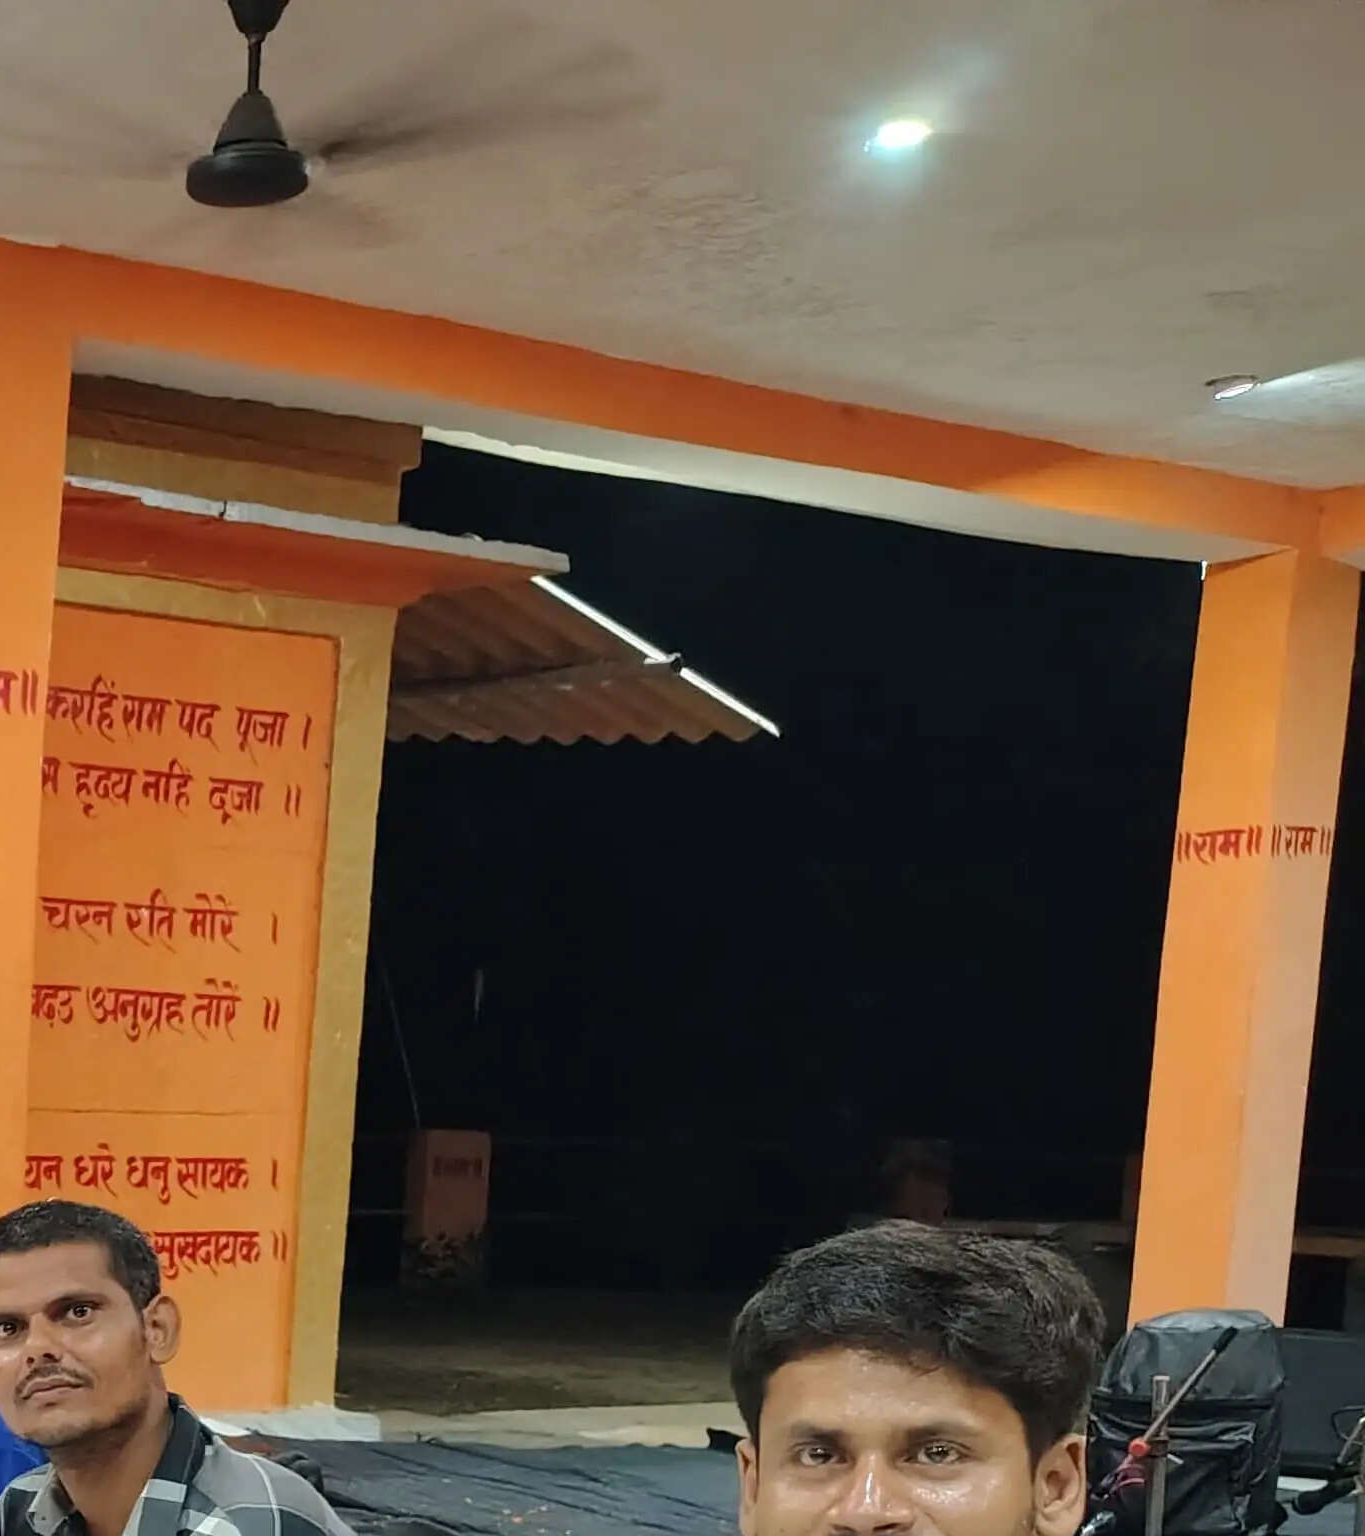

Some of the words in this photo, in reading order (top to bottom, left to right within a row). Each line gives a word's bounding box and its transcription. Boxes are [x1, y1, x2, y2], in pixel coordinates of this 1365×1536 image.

[121, 693, 173, 742] राम
[174, 698, 221, 751] पद
[235, 706, 291, 767] पूजा
[69, 761, 138, 819] हृदय
[207, 777, 265, 825] दूजा
[38, 896, 117, 945] चरन
[123, 888, 178, 953] रति
[86, 985, 187, 1042] अनुग्रह
[125, 1156, 172, 1206] धनु
[176, 1157, 250, 1200] सायक
